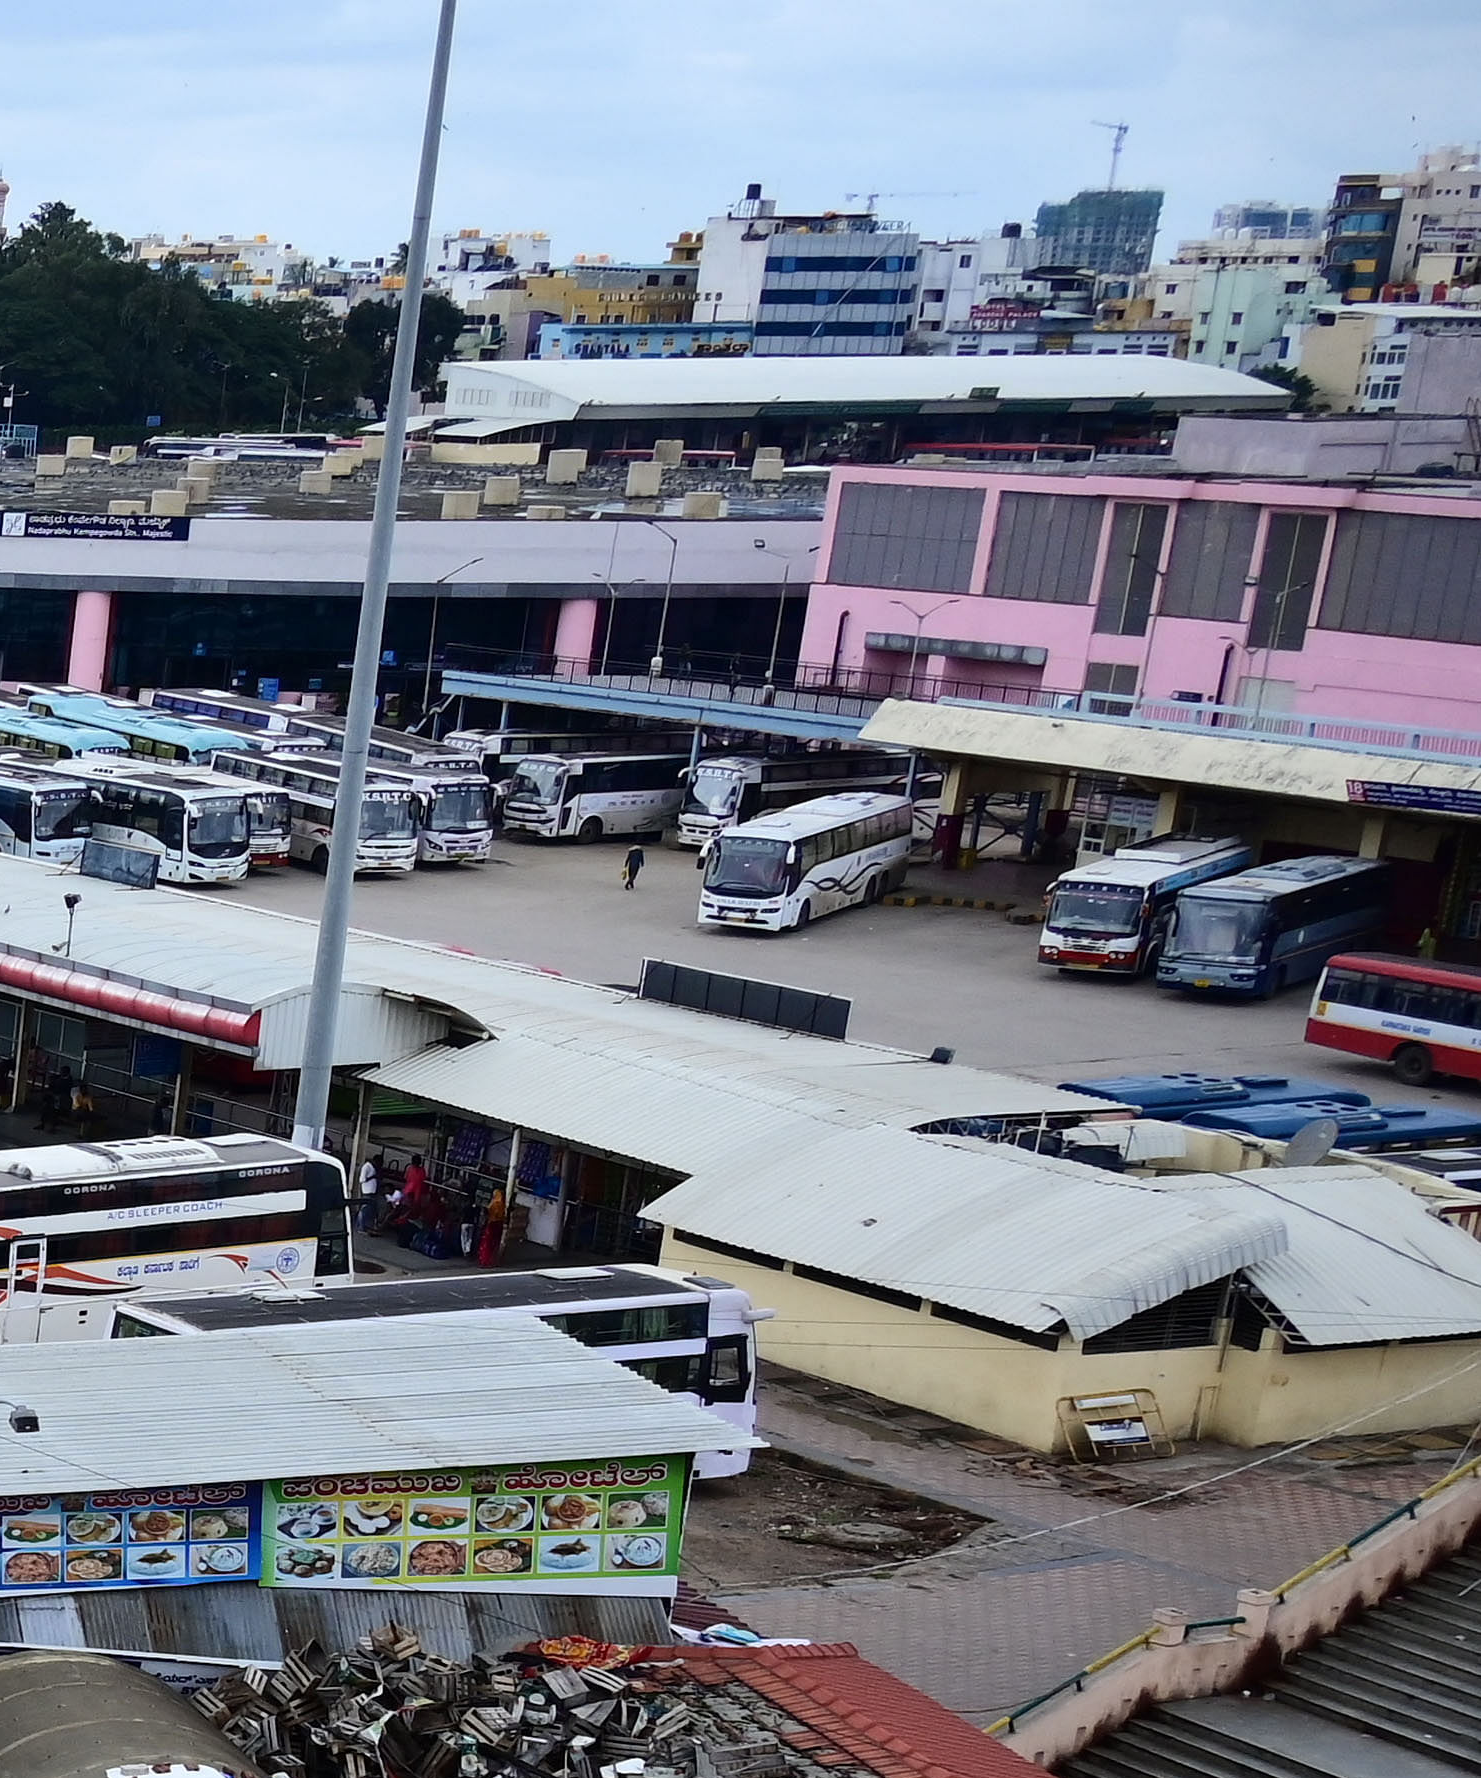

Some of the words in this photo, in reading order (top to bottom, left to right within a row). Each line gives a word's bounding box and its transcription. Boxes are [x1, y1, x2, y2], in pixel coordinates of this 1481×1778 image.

[1347, 781, 1364, 794] 18
[239, 1166, 291, 1177] CORONA
[63, 1183, 117, 1195] CORONA
[127, 1205, 180, 1219] SLEEPER
[182, 1200, 224, 1213] COACH
[502, 1462, 671, 1492] ಹೋಟೆಲ್
